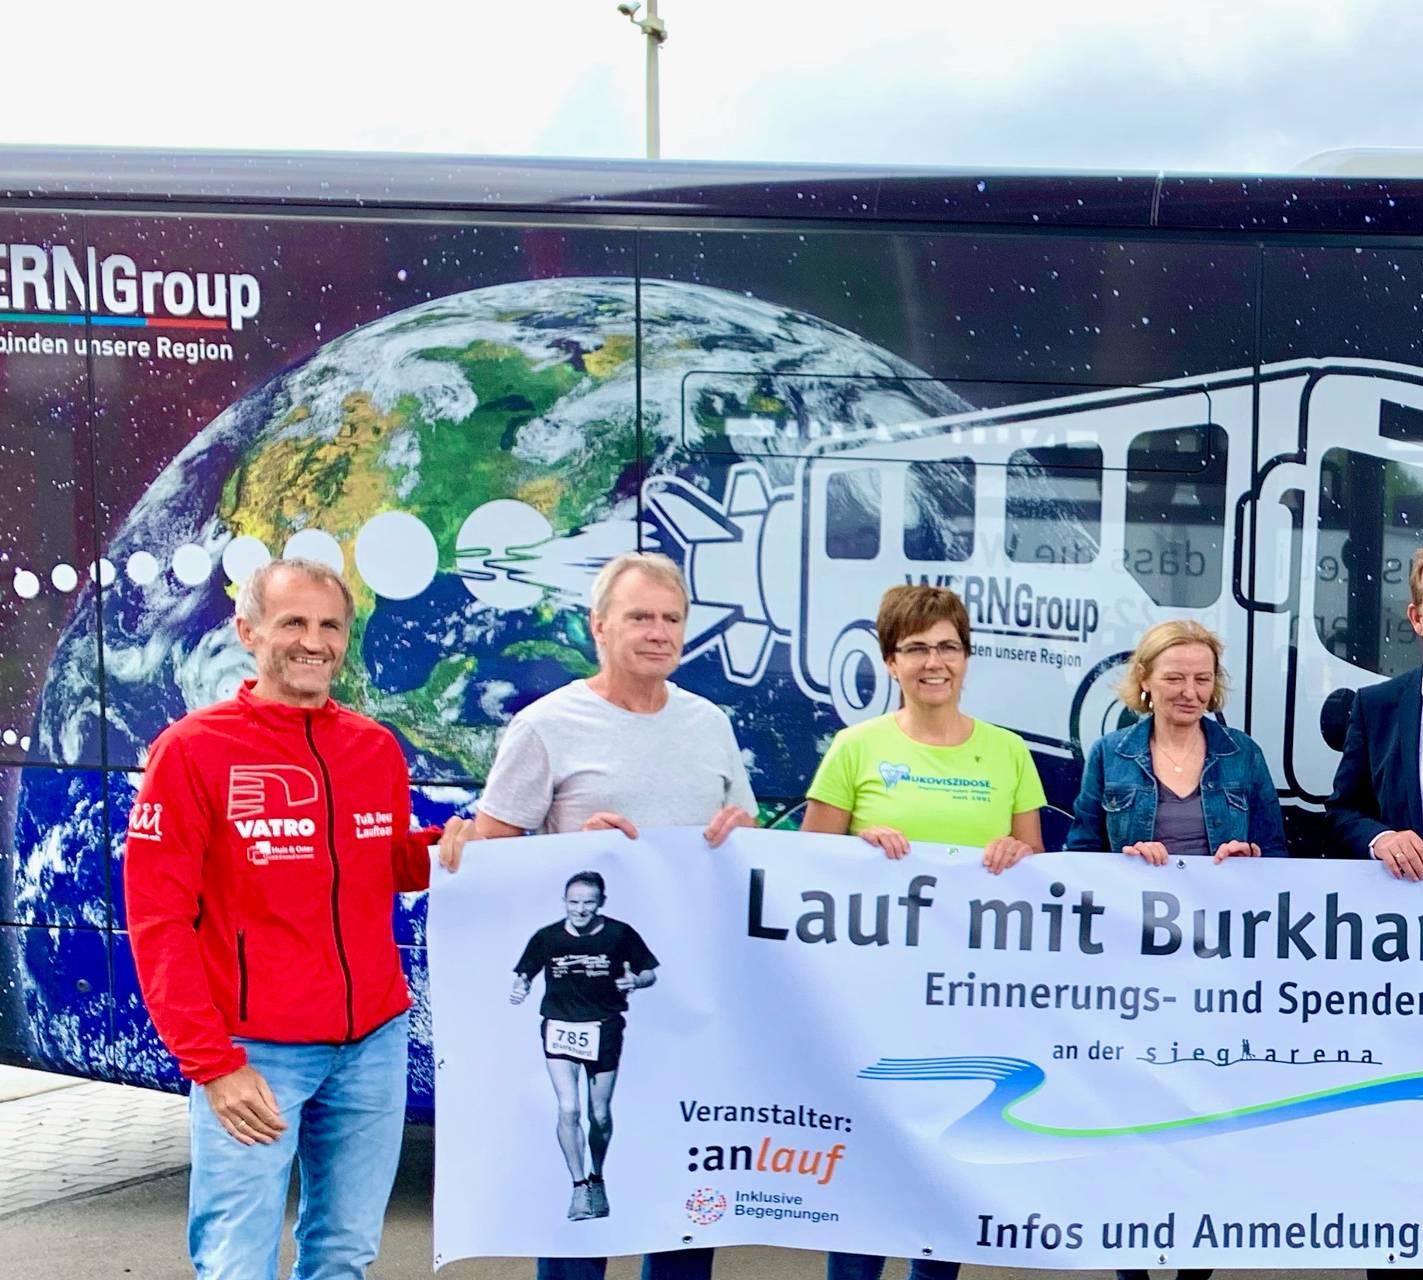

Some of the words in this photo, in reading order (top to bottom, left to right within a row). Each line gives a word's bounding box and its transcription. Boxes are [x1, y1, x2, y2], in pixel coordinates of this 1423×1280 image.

[75, 337, 150, 358] unsere
[157, 336, 233, 365] Region
[905, 573, 1099, 643] RNGroup
[995, 647, 1037, 662] unsere
[1041, 648, 1082, 669] Region
[234, 818, 316, 839] VATRO
[747, 867, 938, 948] Lauf
[967, 881, 1106, 954] mit
[925, 972, 1177, 1020] Erinnerungs-
[1193, 981, 1263, 1015] und
[556, 1028, 590, 1048] 785
[1052, 1044, 1078, 1060] an
[1088, 1040, 1125, 1060] der
[680, 1100, 852, 1133] Veranstalter:
[735, 1191, 803, 1206] Inklusive
[735, 1204, 840, 1223] Begegnungen
[977, 1213, 1084, 1250] Infos
[1101, 1213, 1176, 1250] und
